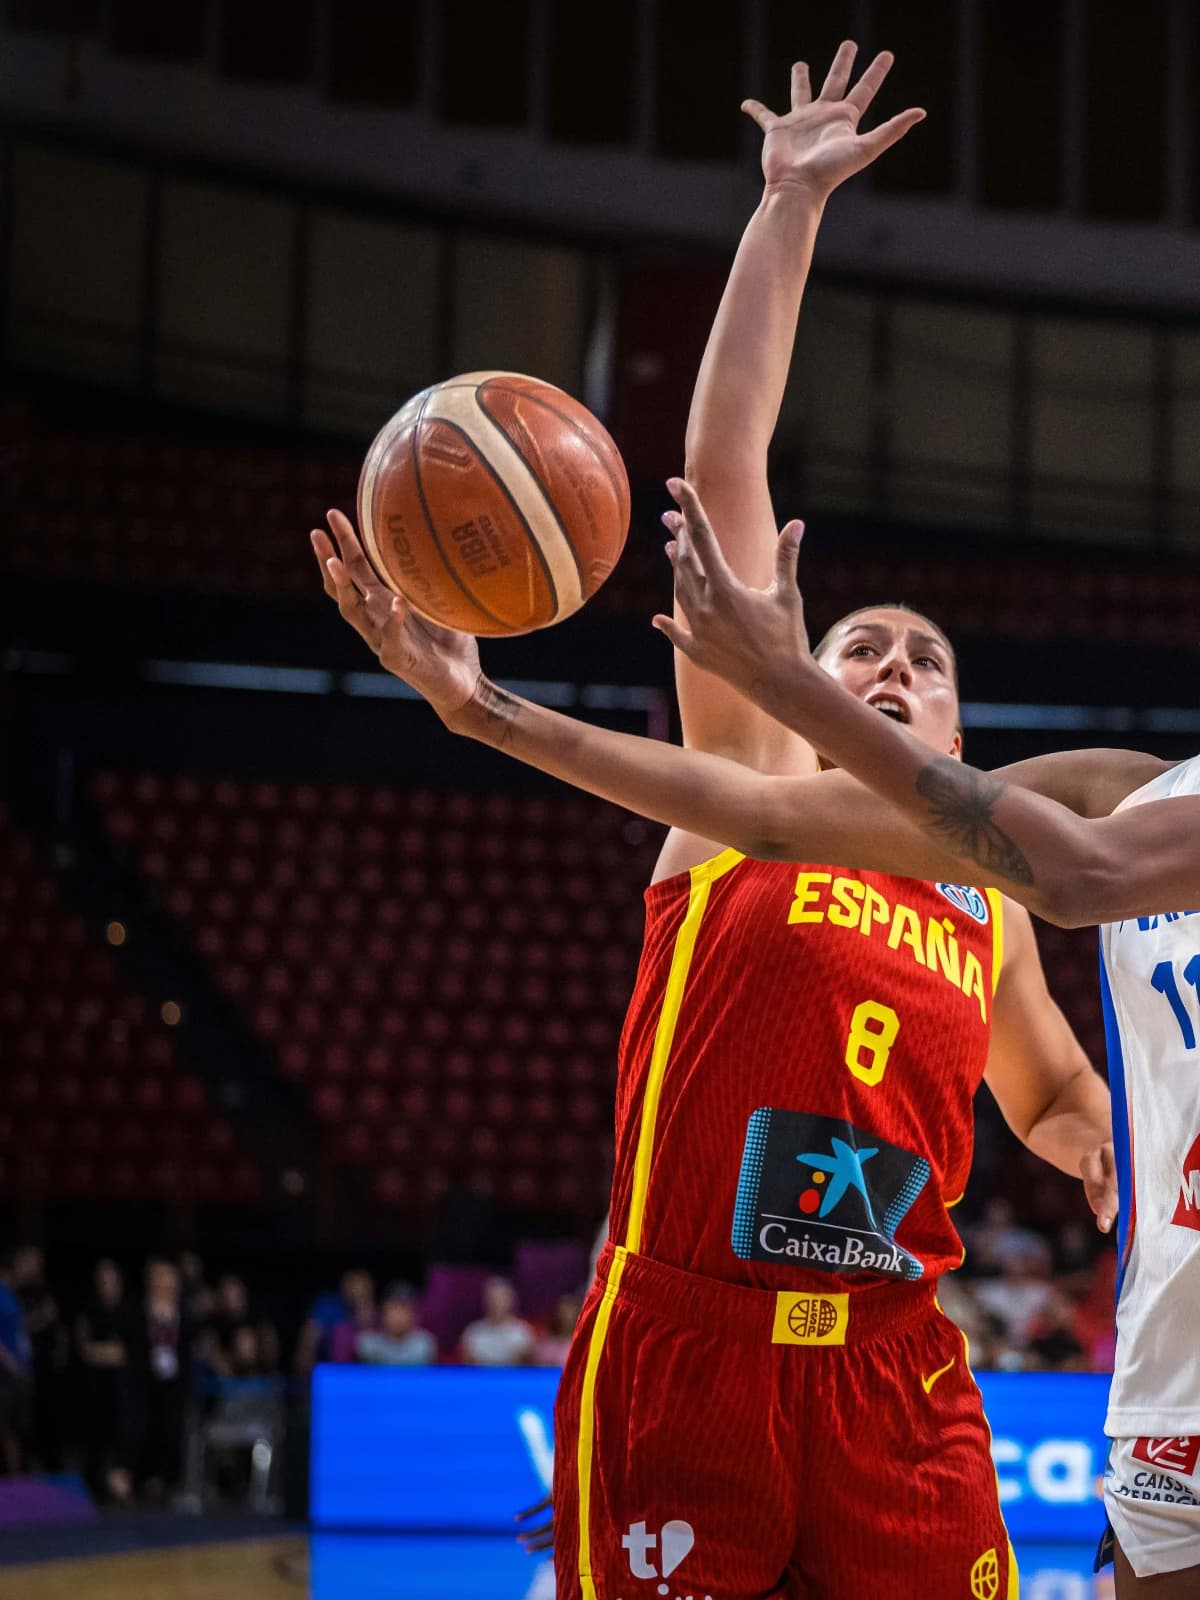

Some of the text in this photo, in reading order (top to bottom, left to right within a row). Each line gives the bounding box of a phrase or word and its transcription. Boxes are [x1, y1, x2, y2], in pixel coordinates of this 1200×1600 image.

[787, 872, 986, 1024] ESPAÑA
[845, 999, 900, 1087] 8
[759, 1223, 902, 1273] CaixaBank
[807, 1299, 819, 1337] ESP
